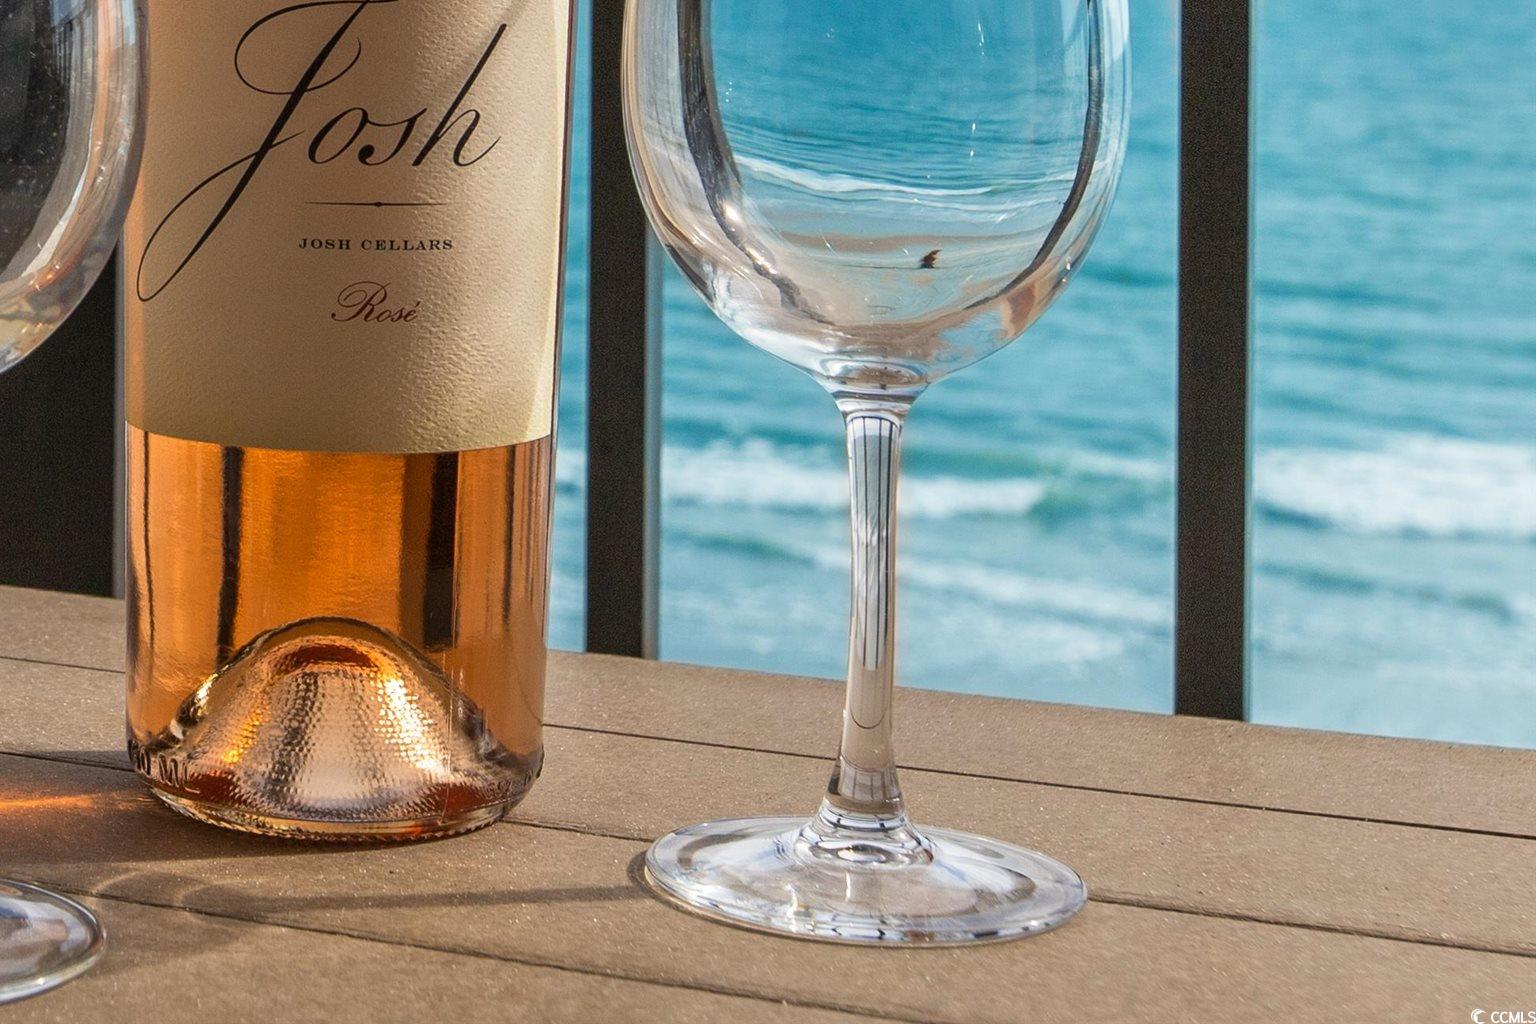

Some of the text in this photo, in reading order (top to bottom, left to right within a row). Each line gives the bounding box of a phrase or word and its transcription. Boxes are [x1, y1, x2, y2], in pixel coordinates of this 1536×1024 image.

[298, 238, 453, 251] JOSH CELLARS
[331, 280, 421, 323] Rosé
